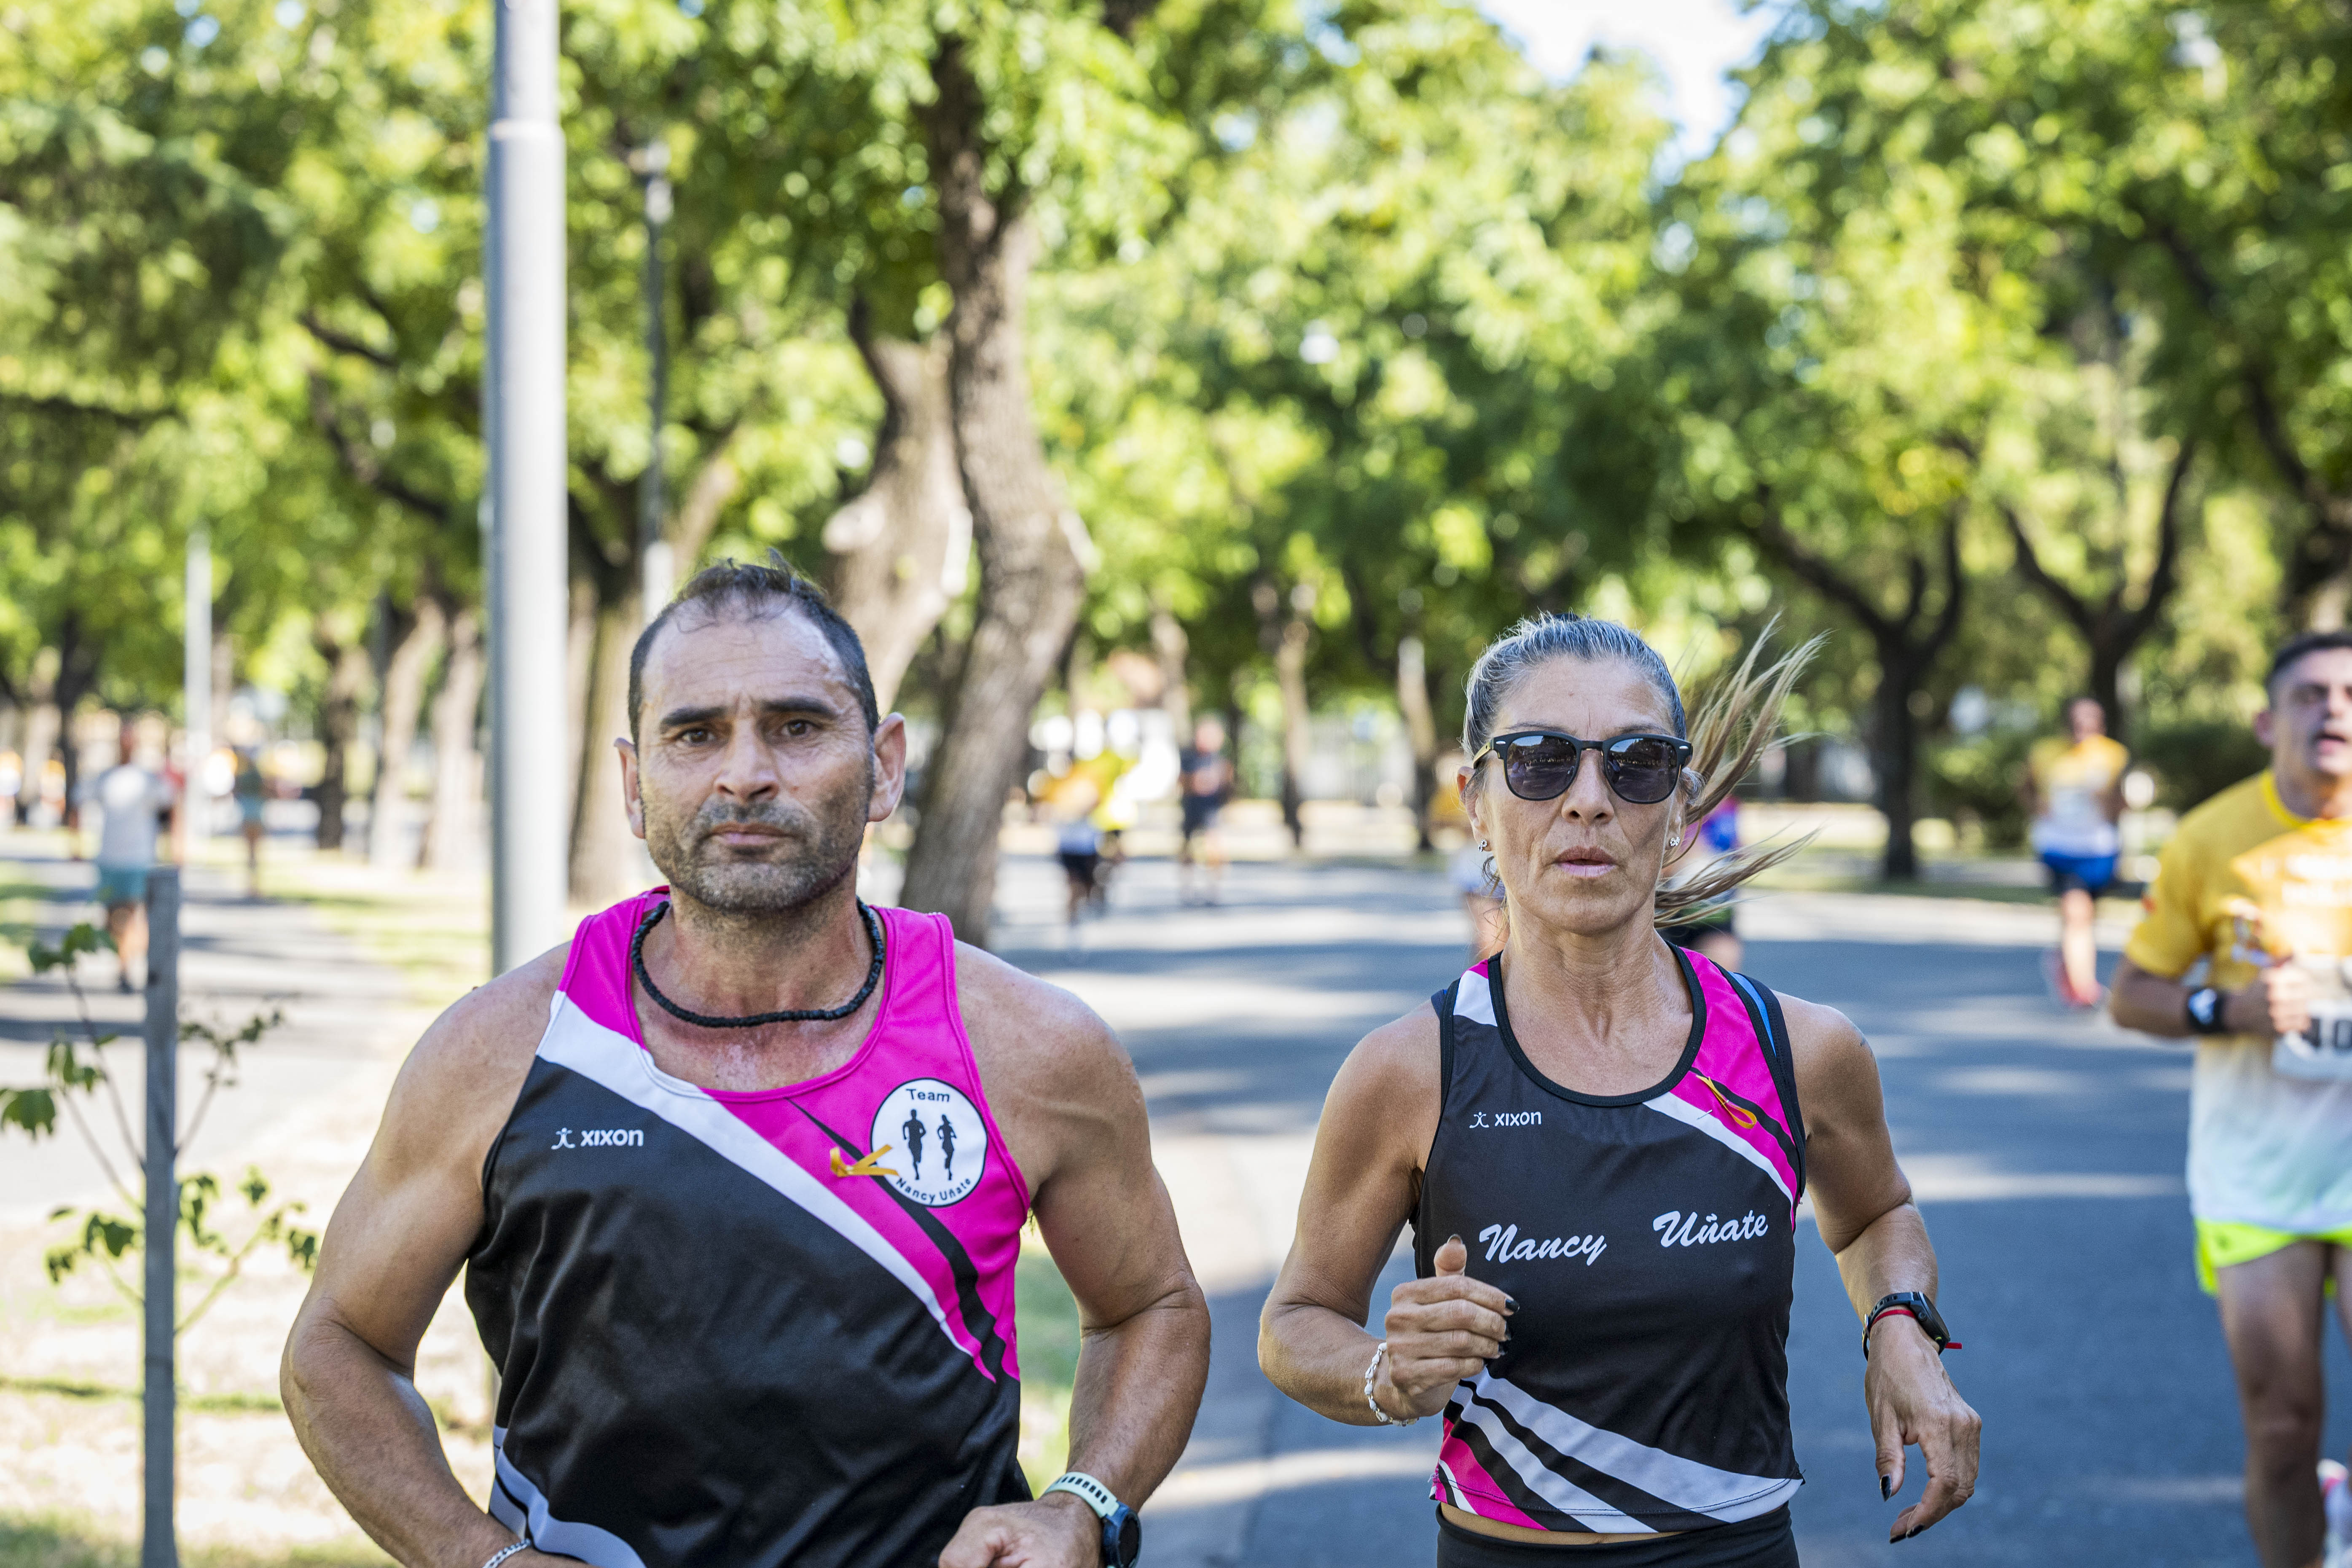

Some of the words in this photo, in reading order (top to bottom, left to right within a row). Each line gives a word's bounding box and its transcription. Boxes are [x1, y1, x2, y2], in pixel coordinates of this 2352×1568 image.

[906, 1088, 950, 1103] Team
[896, 1178, 935, 1204] Nancy
[939, 1178, 972, 1200] Uñate
[1479, 1224, 1607, 1266] Nancy
[1653, 1210, 1768, 1247] Uñate
